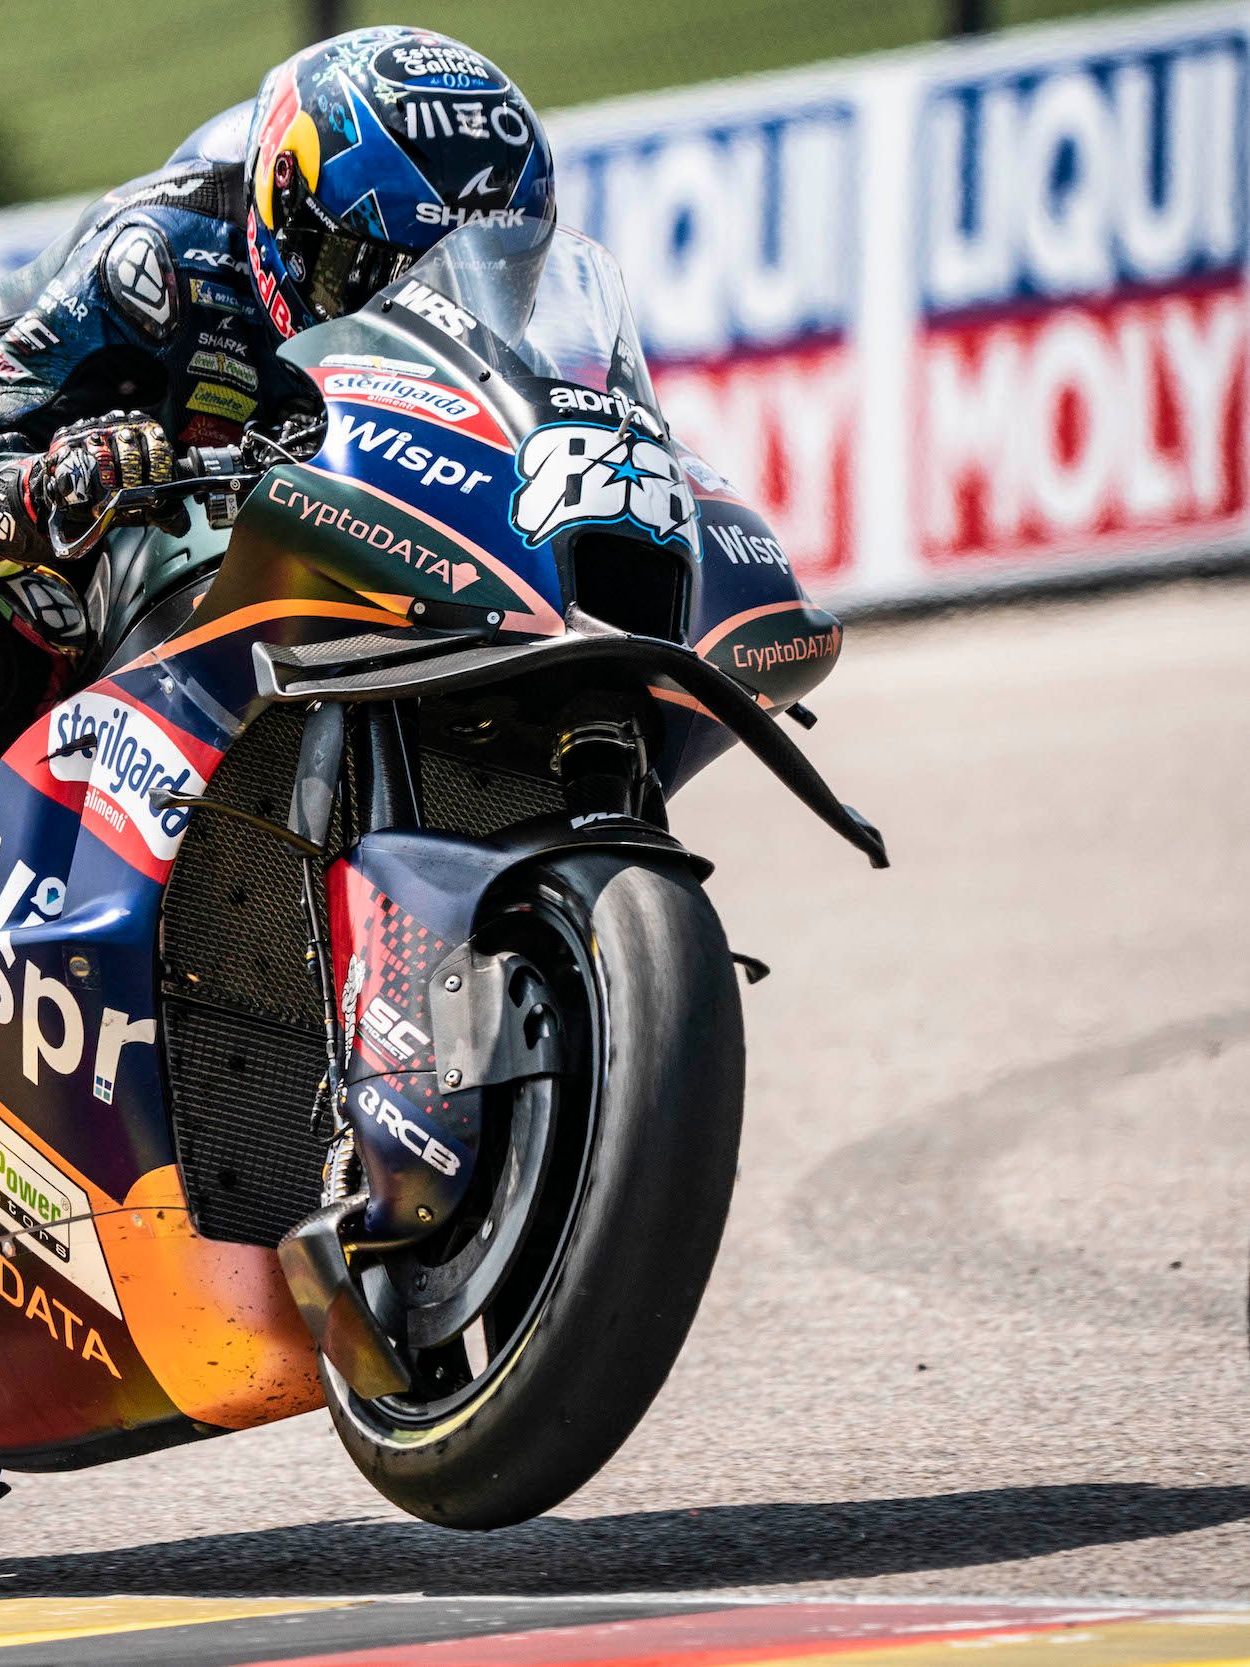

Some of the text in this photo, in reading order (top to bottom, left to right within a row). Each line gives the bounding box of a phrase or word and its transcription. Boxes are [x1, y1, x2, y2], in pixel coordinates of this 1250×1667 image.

[404, 57, 489, 80] Galicia
[405, 100, 530, 146] MEO
[930, 53, 1238, 300] LIQUI
[305, 196, 340, 233] SHARK
[416, 202, 526, 230] SHARK
[394, 279, 478, 338] WRS
[197, 332, 249, 357] SHARK
[332, 373, 467, 418] sterilgarda
[366, 394, 416, 412] alimenti
[550, 386, 644, 425] aprili
[924, 305, 1244, 545] MOLY
[338, 413, 493, 495] Wispr
[514, 424, 702, 559] 88
[267, 477, 452, 586] CryptoDATA
[707, 524, 789, 575] Wisp
[732, 633, 836, 673] CryptoDATA
[57, 703, 192, 838] sterilgarda
[83, 788, 128, 834] alimenti
[359, 1017, 409, 1062] PROJECT
[362, 997, 431, 1058] SC
[376, 1094, 462, 1178] RCB
